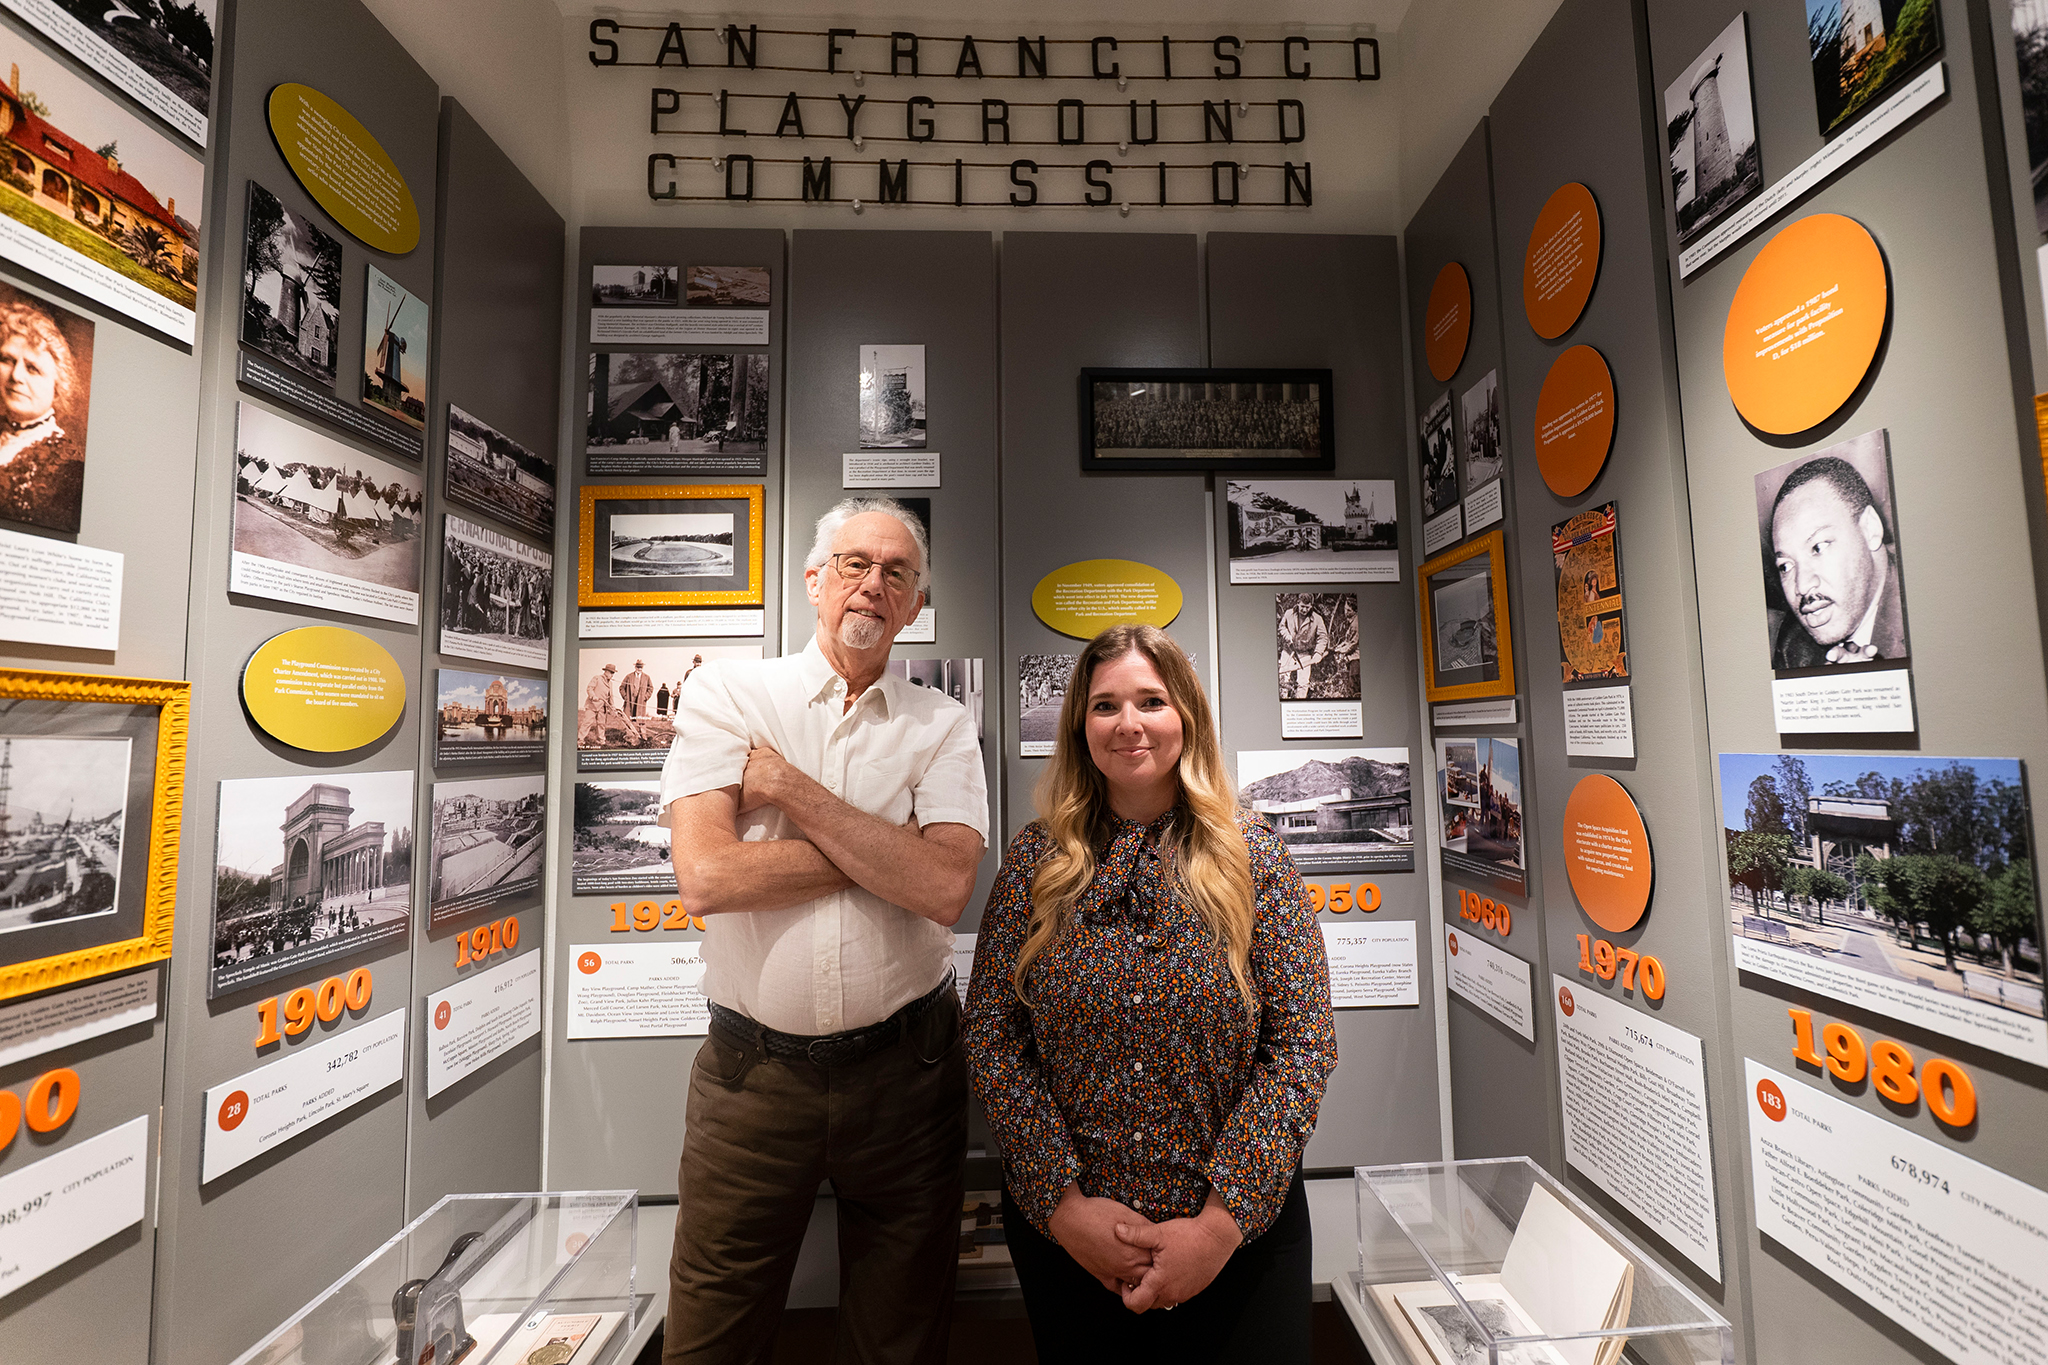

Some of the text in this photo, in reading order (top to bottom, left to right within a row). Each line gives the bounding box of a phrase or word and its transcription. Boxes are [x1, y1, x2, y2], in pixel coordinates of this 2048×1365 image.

[589, 19, 1381, 82] SAN FRANCISCO
[650, 88, 1305, 145] PLAYGROUND
[648, 153, 1312, 207] COMMISSION
[1755, 323, 1774, 335] Voters
[1773, 305, 1800, 326] approved
[1821, 284, 1838, 299] bond
[1763, 302, 1831, 342] measure for park facility
[1755, 308, 1843, 358] improvements with Proposition
[1780, 348, 1790, 356] for
[273, 667, 291, 675] Charter
[291, 660, 316, 668] Playground
[1458, 889, 1511, 937] 1960
[455, 916, 519, 968] 1910
[671, 956, 704, 965] 506,676
[1337, 937, 1367, 946] 775,357
[584, 959, 595, 967] 56
[1576, 934, 1666, 1001] 1970
[256, 968, 373, 1048] 1900
[1561, 995, 1572, 1007] 160
[327, 1034, 398, 1073] 342,782 CITY POPULATION
[1608, 1036, 1633, 1053] PARKS ADDED
[1625, 1026, 1694, 1066] 715,674 CITY POPULATION
[1788, 1009, 1977, 1127] 1980
[227, 1102, 241, 1118] 28
[253, 1085, 287, 1104] TOTAL PARKS
[259, 1130, 277, 1143] Corona
[278, 1121, 295, 1133] Heights
[308, 1106, 324, 1118] Lincoln
[356, 1083, 369, 1092] Square
[302, 1088, 335, 1107] PARKS ADDED
[1762, 1091, 1781, 1109] 183
[1791, 1107, 1832, 1133] TOTAL PARKS
[62, 1181, 81, 1195] CITY
[83, 1155, 134, 1185] POPULATION
[1760, 1137, 1773, 1148] Anza
[1774, 1144, 1793, 1159] Branch
[1818, 1169, 1845, 1188] Arlington
[1847, 1184, 1884, 1210] Community
[1858, 1174, 1909, 1207] PARKS ADDED
[1891, 1155, 1950, 1194] 678,974
[1960, 1191, 1980, 1206] CITY
